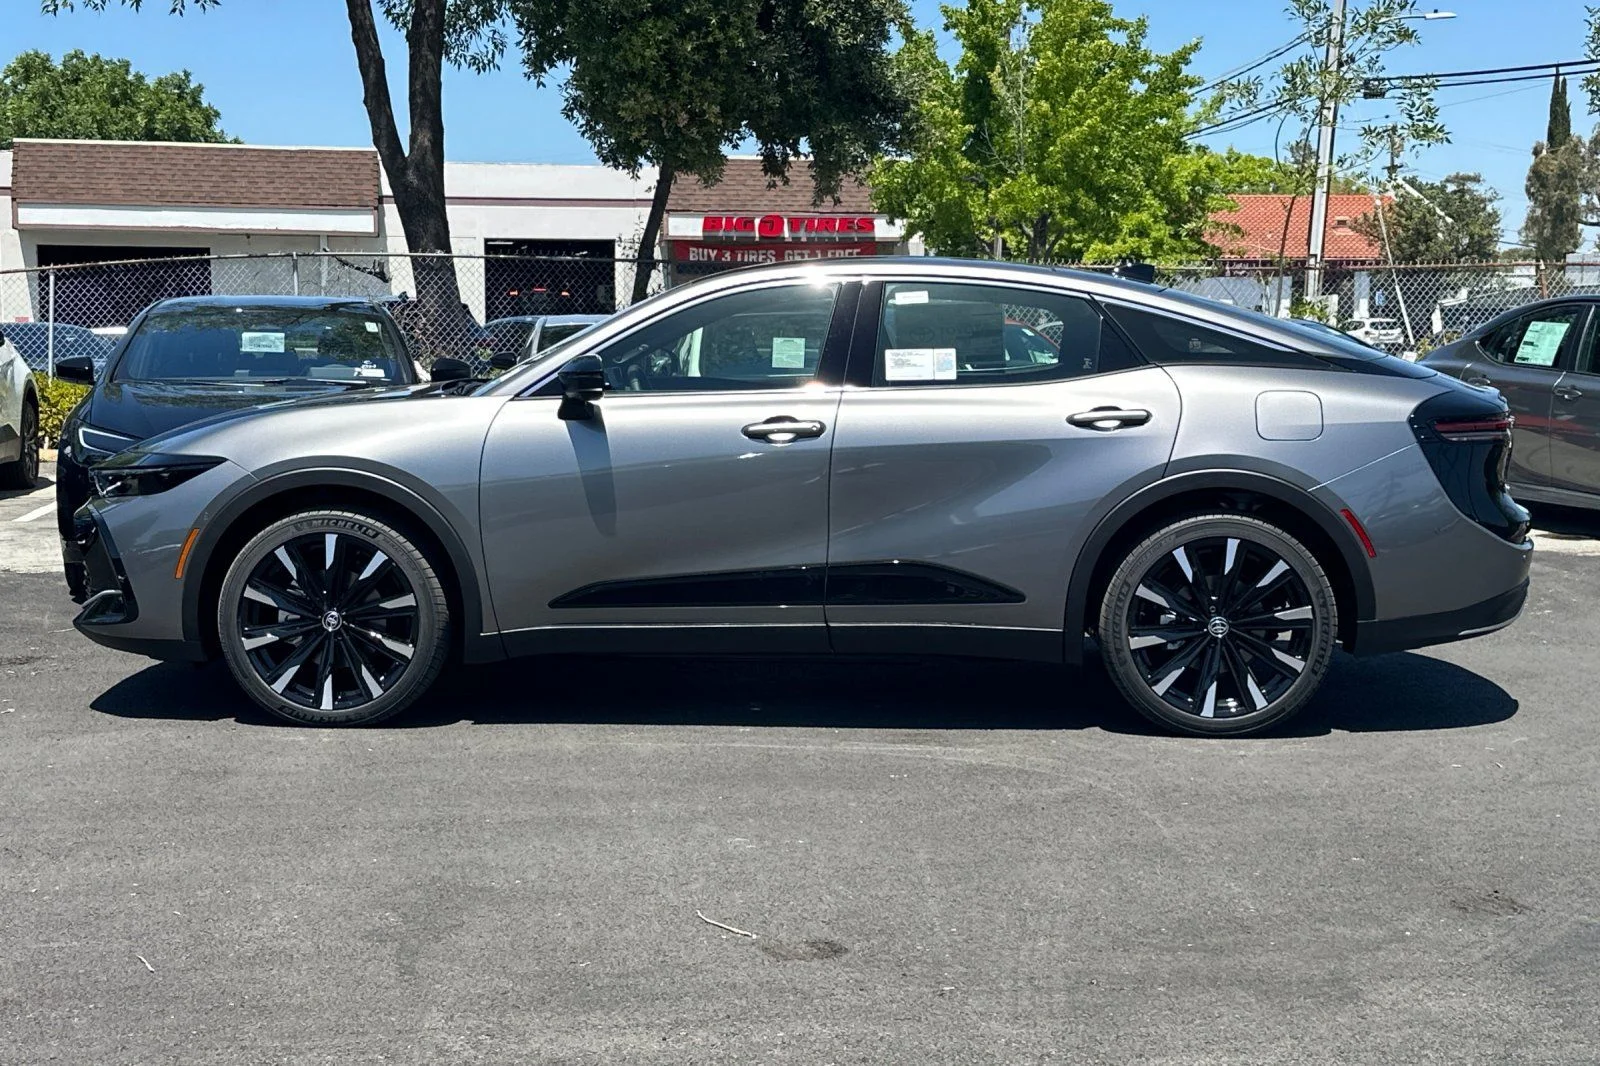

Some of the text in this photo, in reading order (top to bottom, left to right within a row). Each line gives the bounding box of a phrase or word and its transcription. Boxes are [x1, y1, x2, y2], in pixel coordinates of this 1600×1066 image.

[703, 213, 875, 238] BIG O TIRES
[689, 248, 718, 261] BUY
[722, 250, 731, 262] 3
[735, 250, 776, 263] TIRES
[784, 250, 810, 261] GET
[311, 519, 377, 537] MICHELIN
